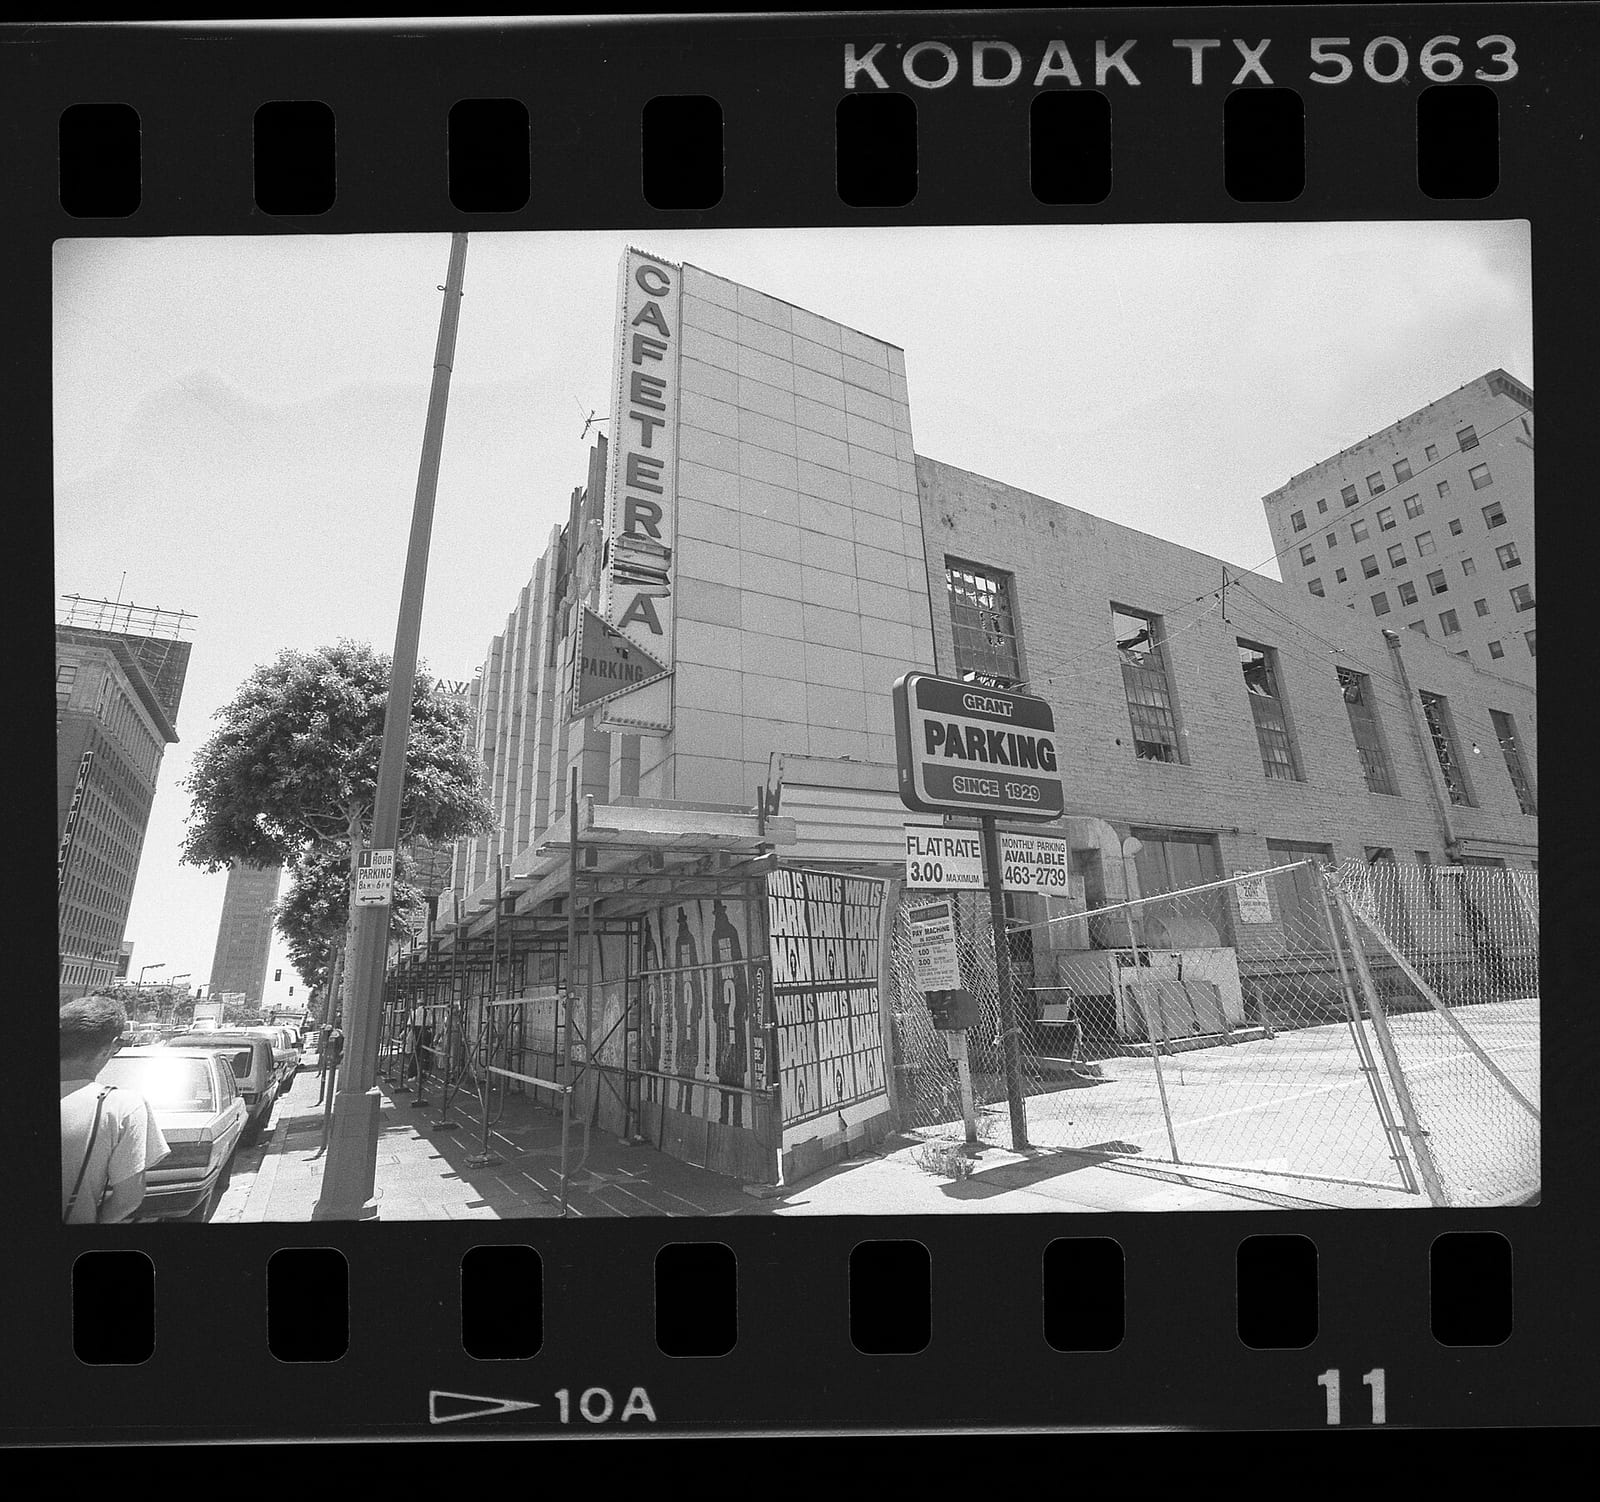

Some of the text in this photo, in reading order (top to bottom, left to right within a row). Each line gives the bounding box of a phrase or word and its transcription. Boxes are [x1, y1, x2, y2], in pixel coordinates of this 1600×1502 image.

[844, 34, 1519, 89] KODAK TX 5063
[618, 264, 671, 636] CAFETERA
[581, 656, 643, 681] PARKING
[963, 694, 1013, 716] GRANT
[924, 719, 1057, 772] PARKING
[953, 776, 1040, 801] SINCE 1929
[373, 855, 392, 865] HOUR
[907, 836, 980, 858] FLAT RATE
[1002, 838, 1065, 852] MONTHLY PARKING
[1005, 850, 1065, 865] AVAILABLE
[359, 868, 391, 879] PARKING
[768, 870, 805, 899] WHO IS
[805, 874, 842, 903] WHO IS
[911, 862, 980, 883] 3.00 MAXIMUM
[1005, 866, 1066, 886] 463-2739
[845, 879, 882, 907] WHO IS
[768, 896, 809, 936] DARK
[808, 900, 844, 938] DARK
[844, 904, 879, 939] DARK
[770, 937, 812, 982] MAN
[812, 939, 846, 981] MAN
[846, 940, 878, 979] MAN
[776, 994, 803, 1026] WHO
[803, 993, 815, 1023] IS
[816, 990, 849, 1020] WHO IS
[850, 987, 878, 1015] WHO IS
[777, 1022, 818, 1070] DARK
[818, 1017, 851, 1061] DARK
[851, 1012, 882, 1053] DARK
[820, 1054, 855, 1107] MAN
[854, 1047, 886, 1097] MAN
[780, 1063, 820, 1121] MAN
[554, 1387, 657, 1424] 10A
[1317, 1368, 1386, 1425] 11
